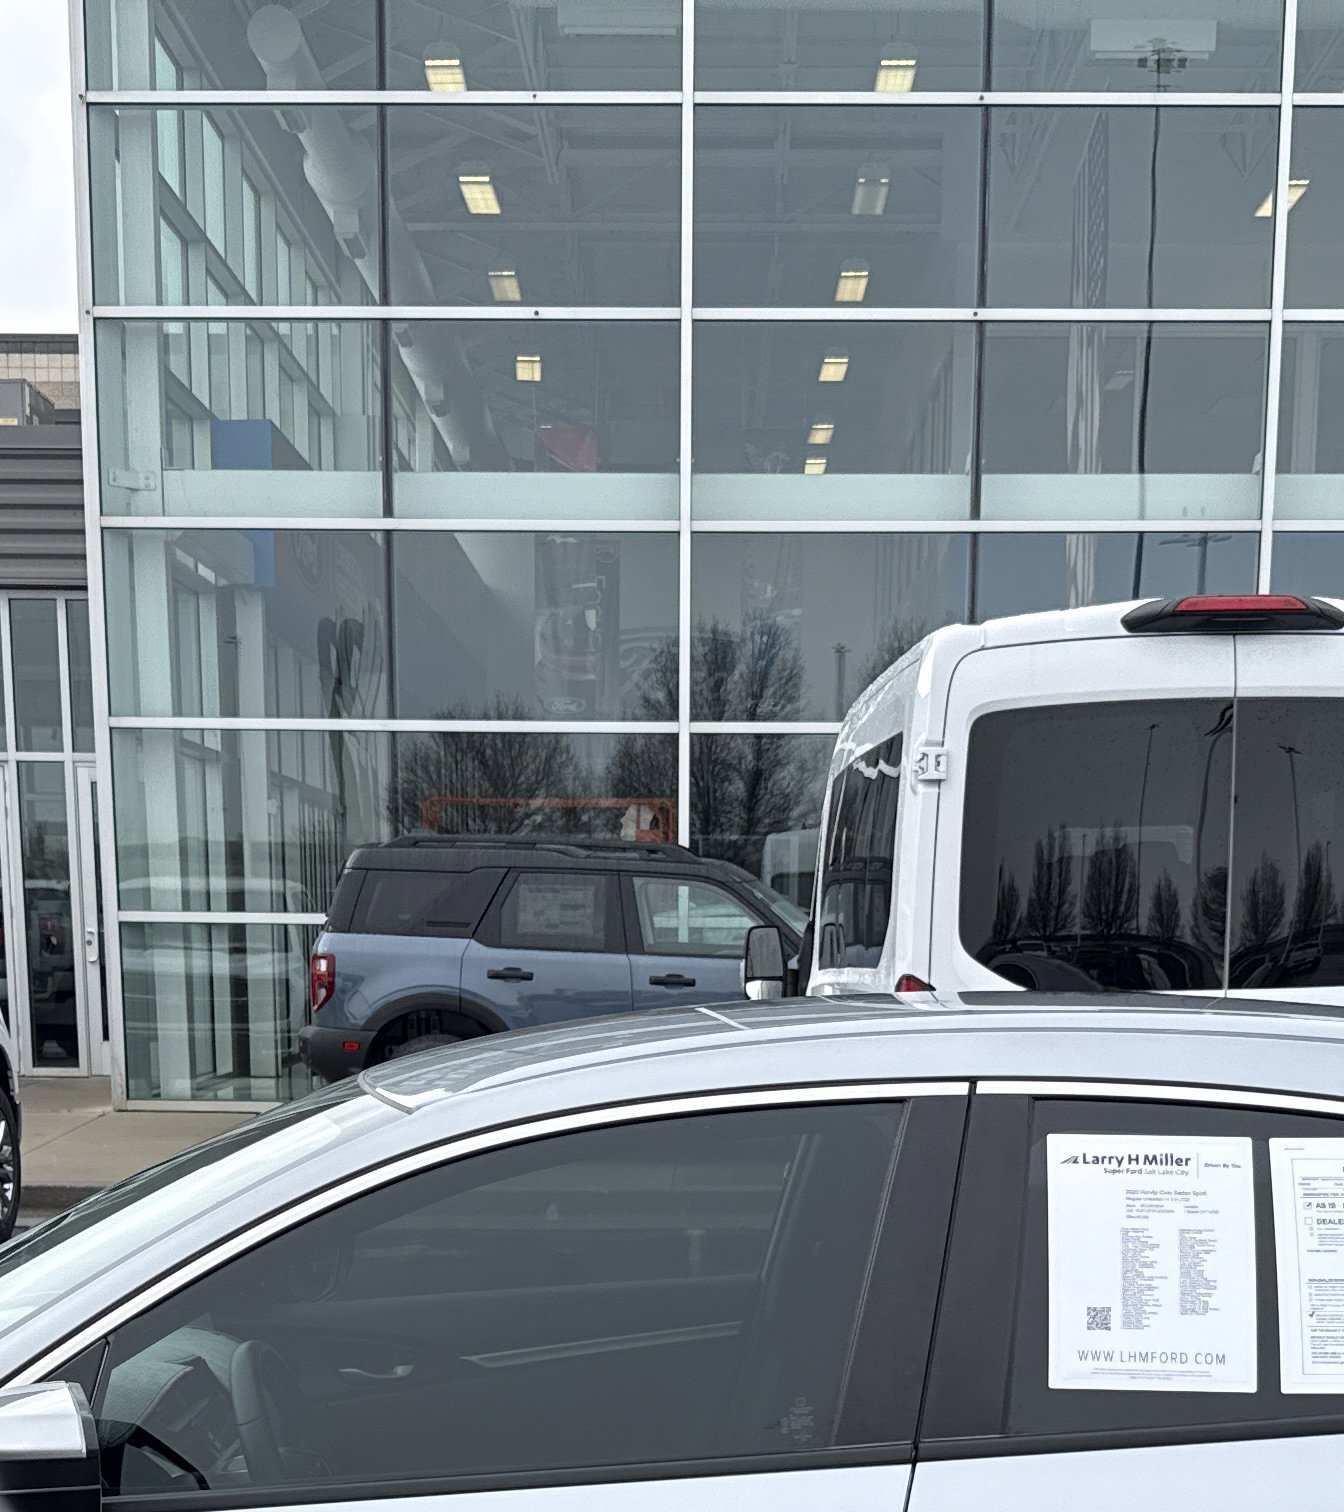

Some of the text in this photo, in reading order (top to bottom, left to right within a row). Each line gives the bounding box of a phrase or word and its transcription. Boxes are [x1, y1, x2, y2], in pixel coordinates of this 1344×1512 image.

[1082, 1152, 1192, 1168] Larry H Miller
[1104, 1168, 1124, 1176] Super
